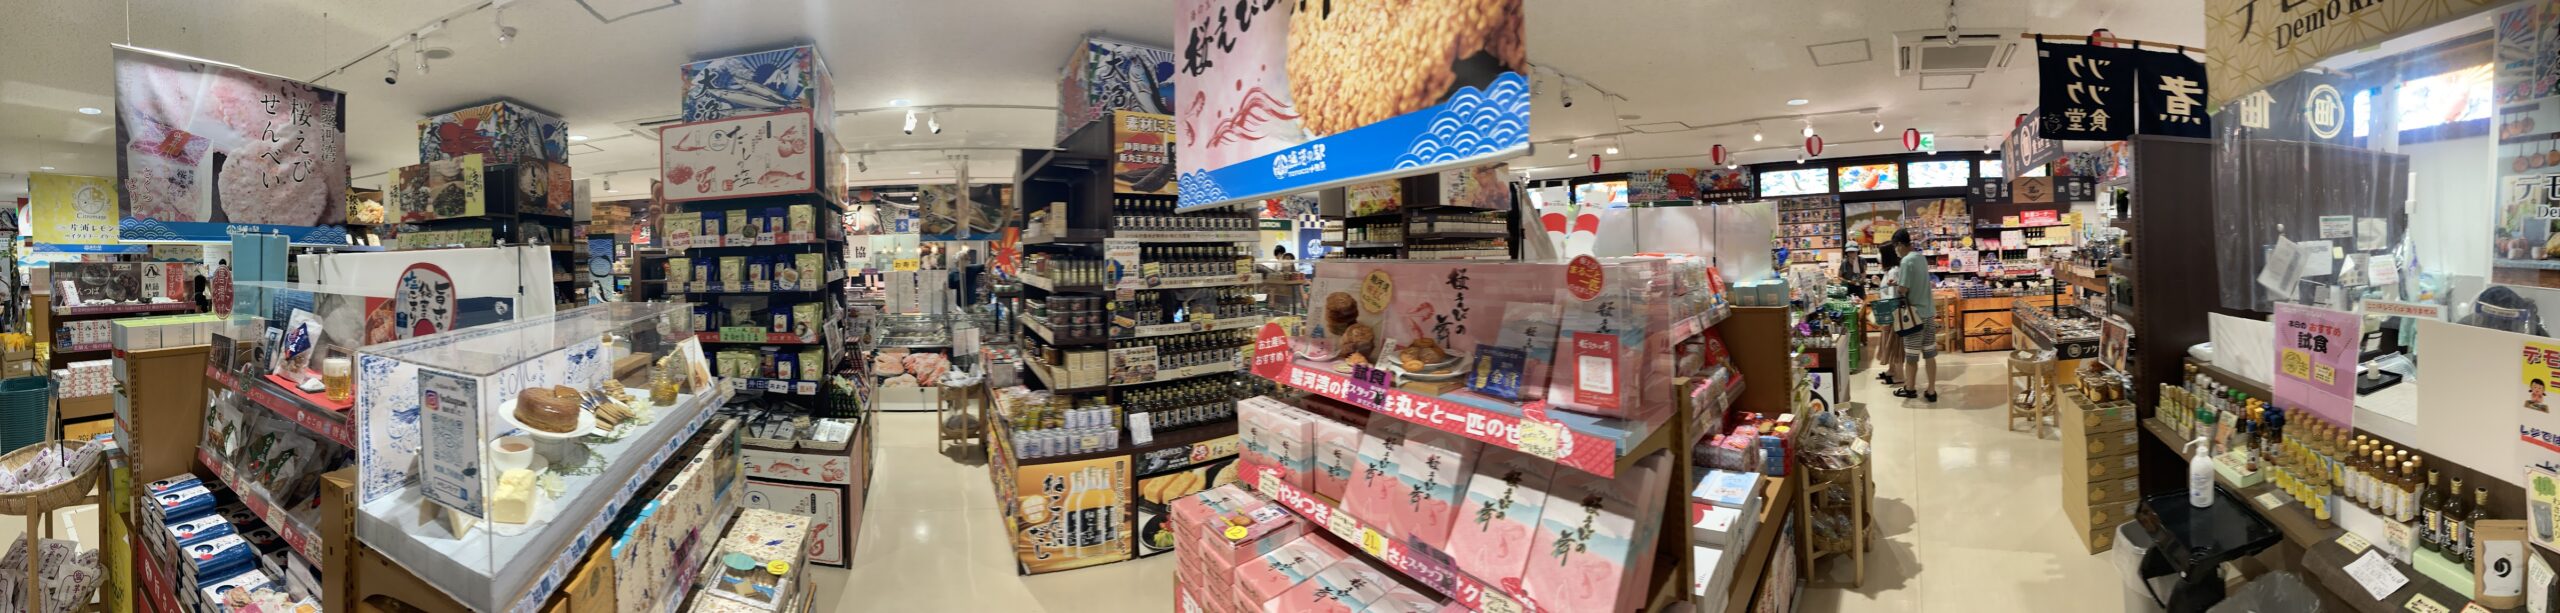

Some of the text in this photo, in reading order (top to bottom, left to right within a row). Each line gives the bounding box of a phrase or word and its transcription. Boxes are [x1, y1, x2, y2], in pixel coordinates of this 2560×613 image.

[260, 94, 281, 189] せんべい
[292, 98, 313, 183] 桜えび
[321, 103, 337, 163] 駿河湾
[2297, 331, 2329, 354] 試食
[1279, 483, 1330, 525] やみつき
